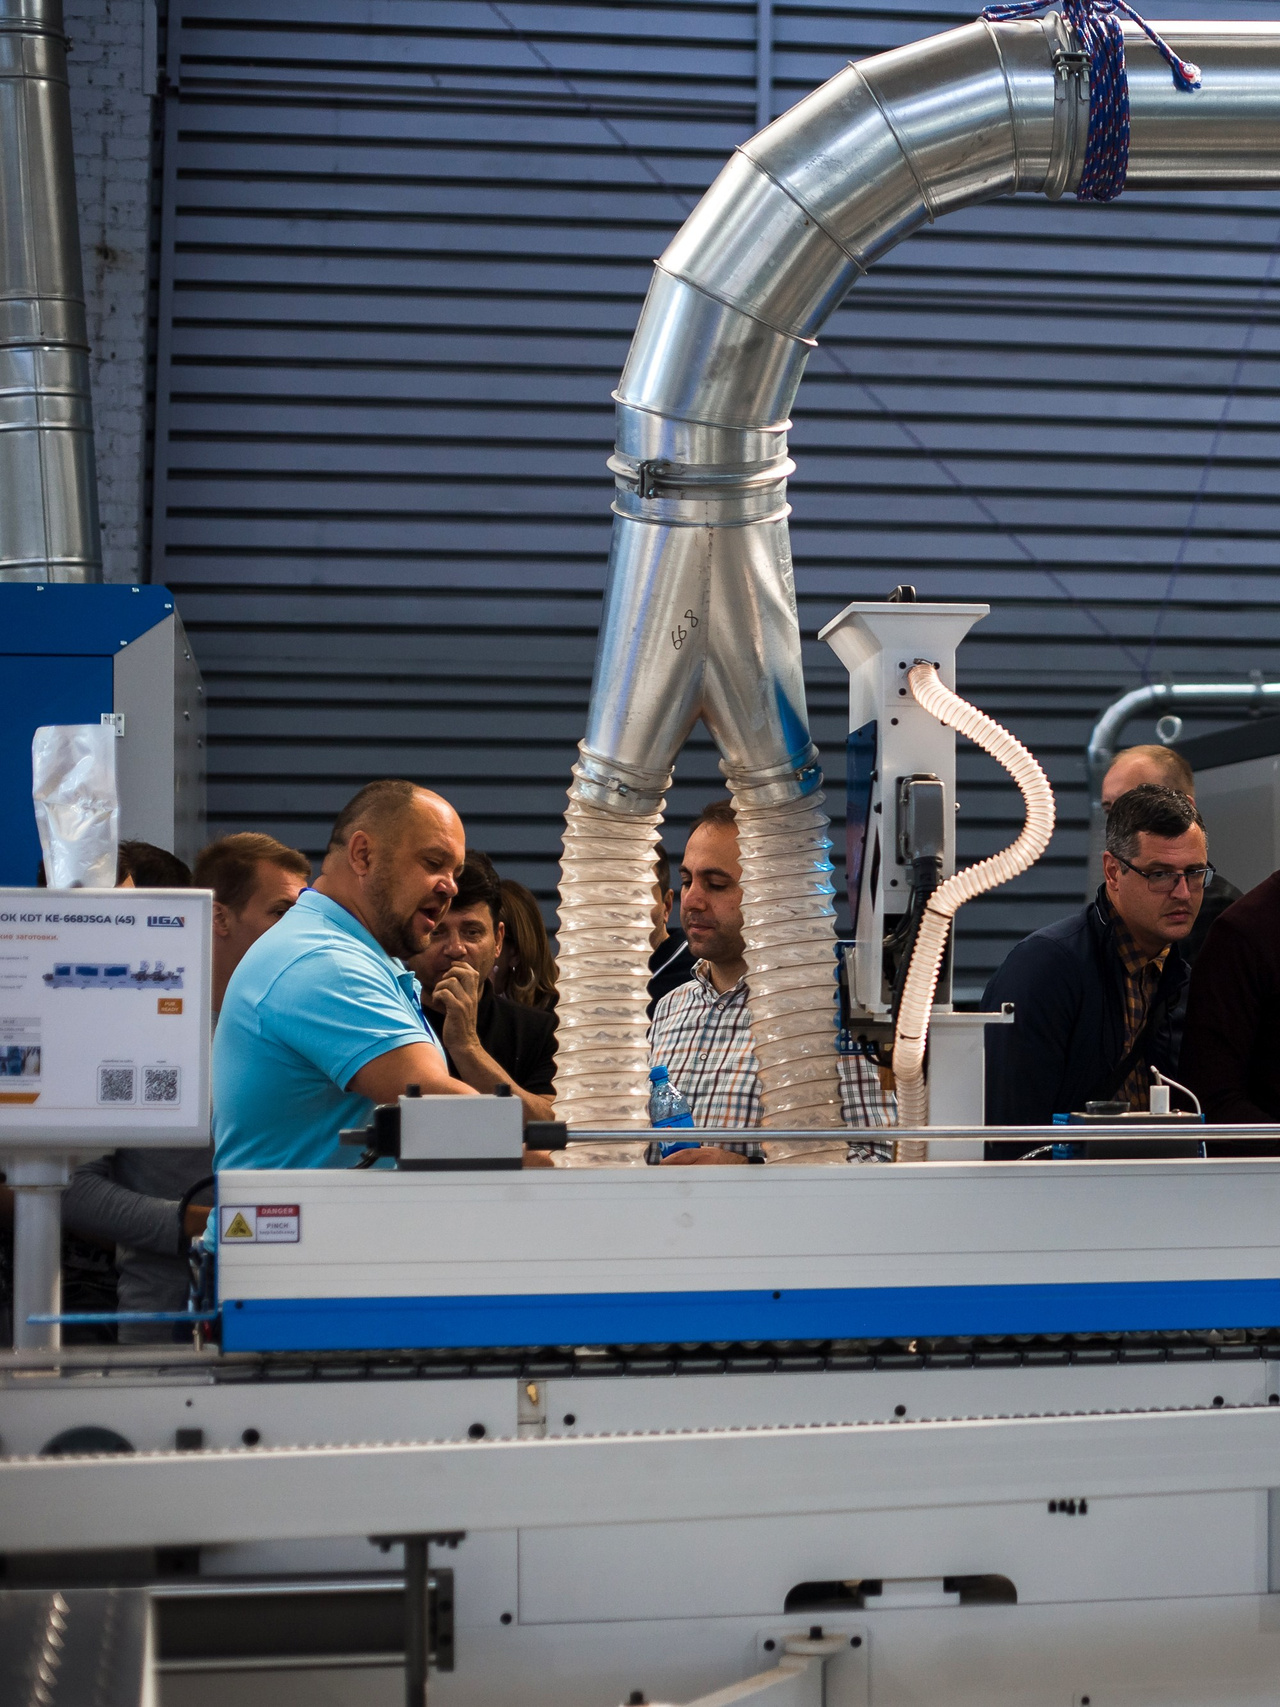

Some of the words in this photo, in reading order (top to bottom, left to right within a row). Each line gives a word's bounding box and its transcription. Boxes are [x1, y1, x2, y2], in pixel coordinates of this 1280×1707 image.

[20, 914, 42, 922] KDT
[115, 915, 135, 925] (45)
[147, 916, 185, 927] LIGA
[261, 1207, 294, 1215] DANGER
